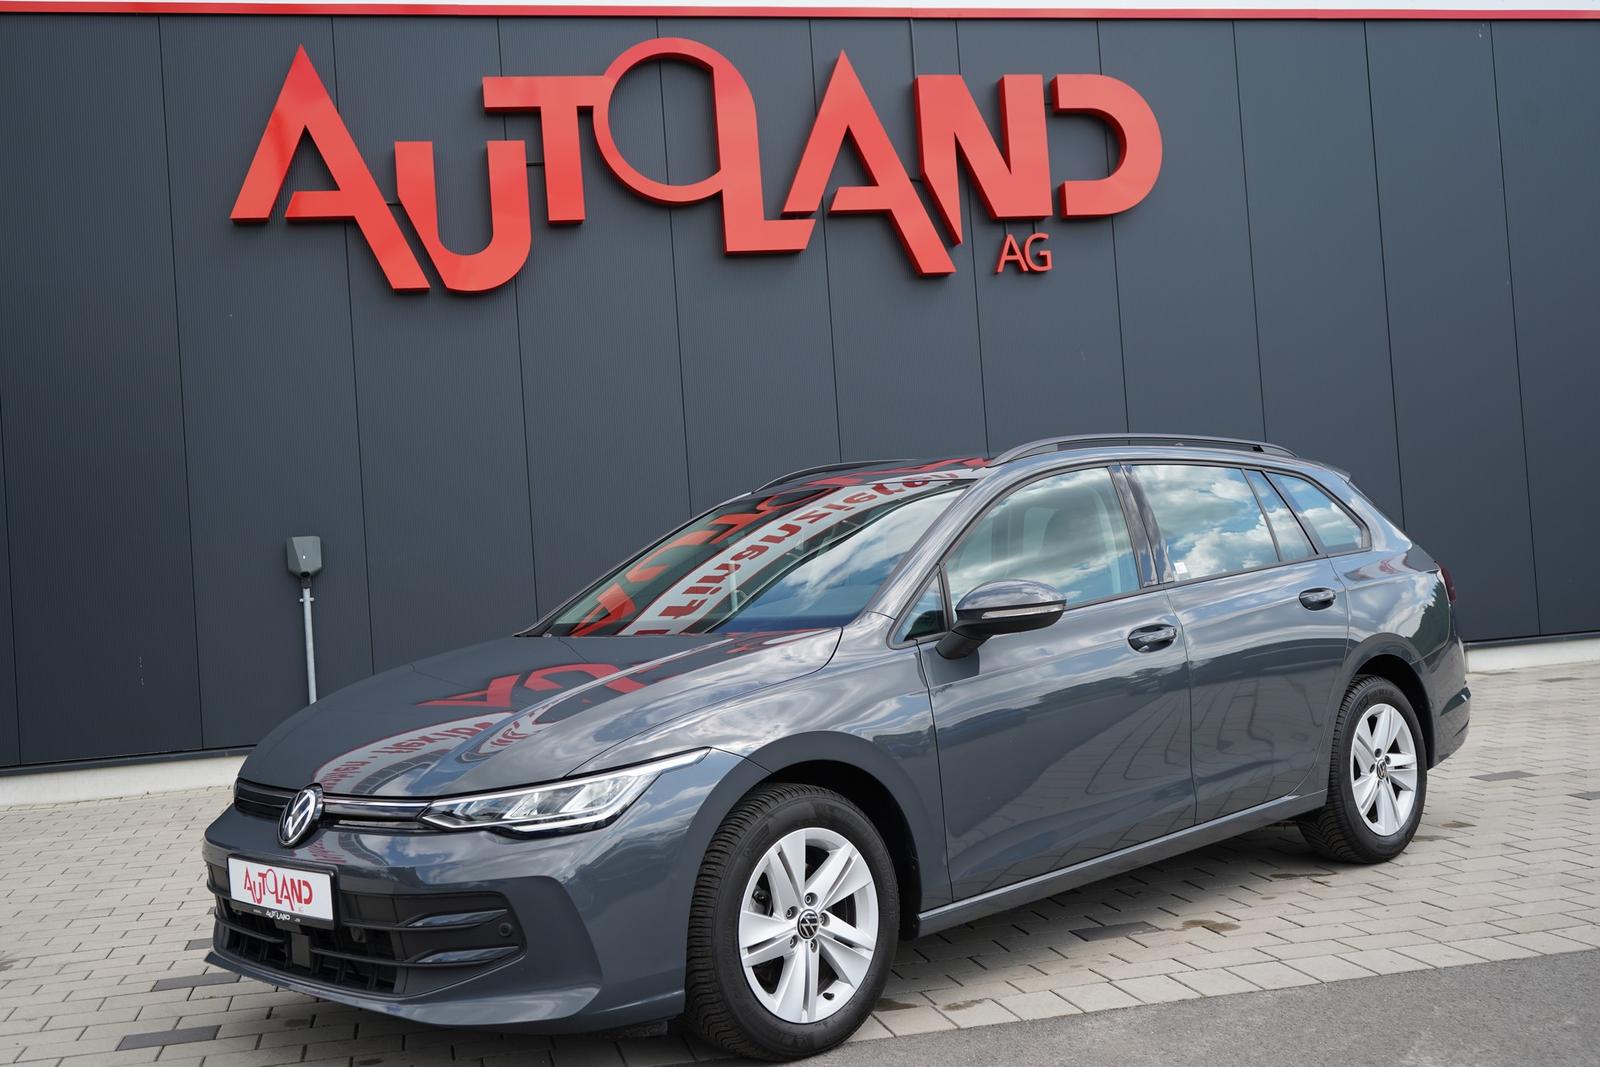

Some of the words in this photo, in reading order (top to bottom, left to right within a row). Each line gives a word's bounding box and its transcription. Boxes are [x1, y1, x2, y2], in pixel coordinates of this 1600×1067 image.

[231, 37, 1163, 292] AUTOLAND
[996, 232, 1053, 273] AG
[244, 867, 313, 911] AUTOLAND
